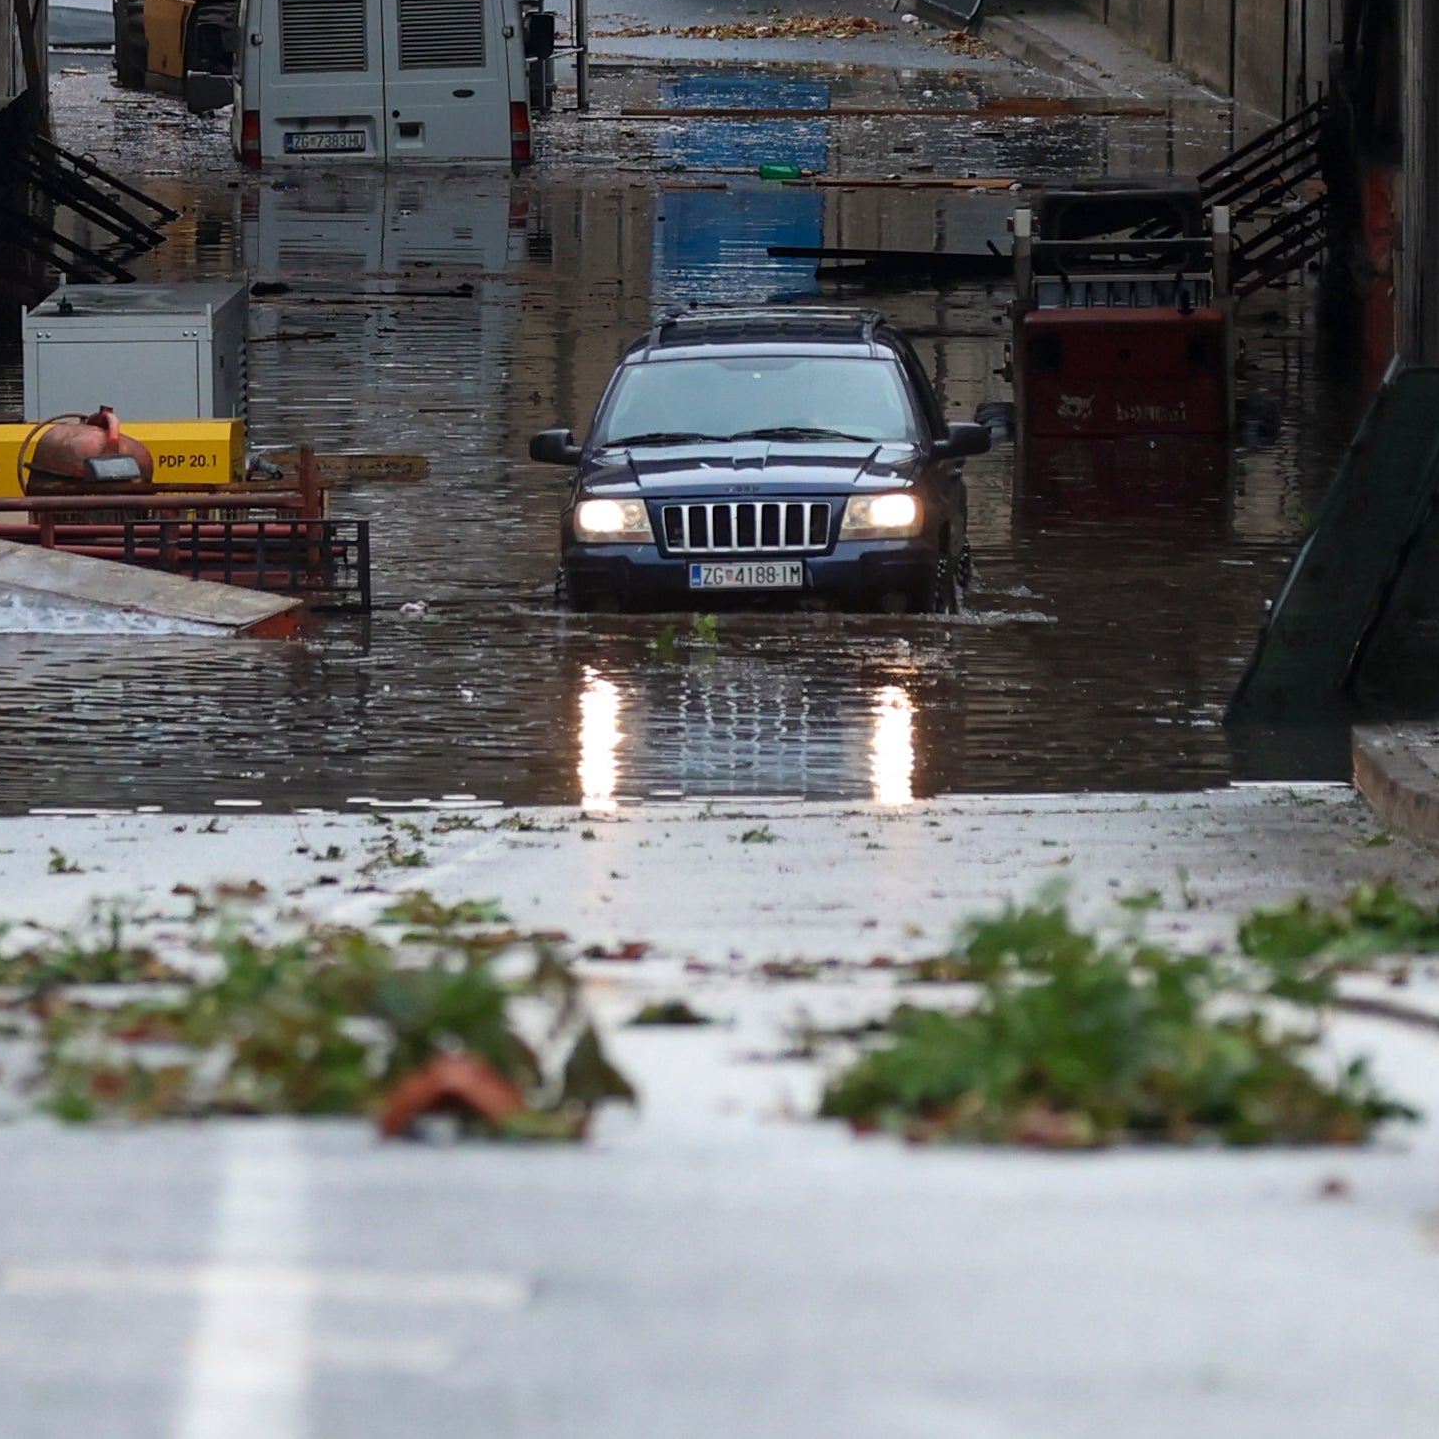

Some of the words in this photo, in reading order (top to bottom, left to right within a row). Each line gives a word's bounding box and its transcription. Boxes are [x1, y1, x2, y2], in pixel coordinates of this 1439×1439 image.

[294, 135, 309, 149] ZG
[158, 455, 186, 468] PDP
[189, 454, 218, 467] 20.1
[703, 567, 723, 584] ZG
